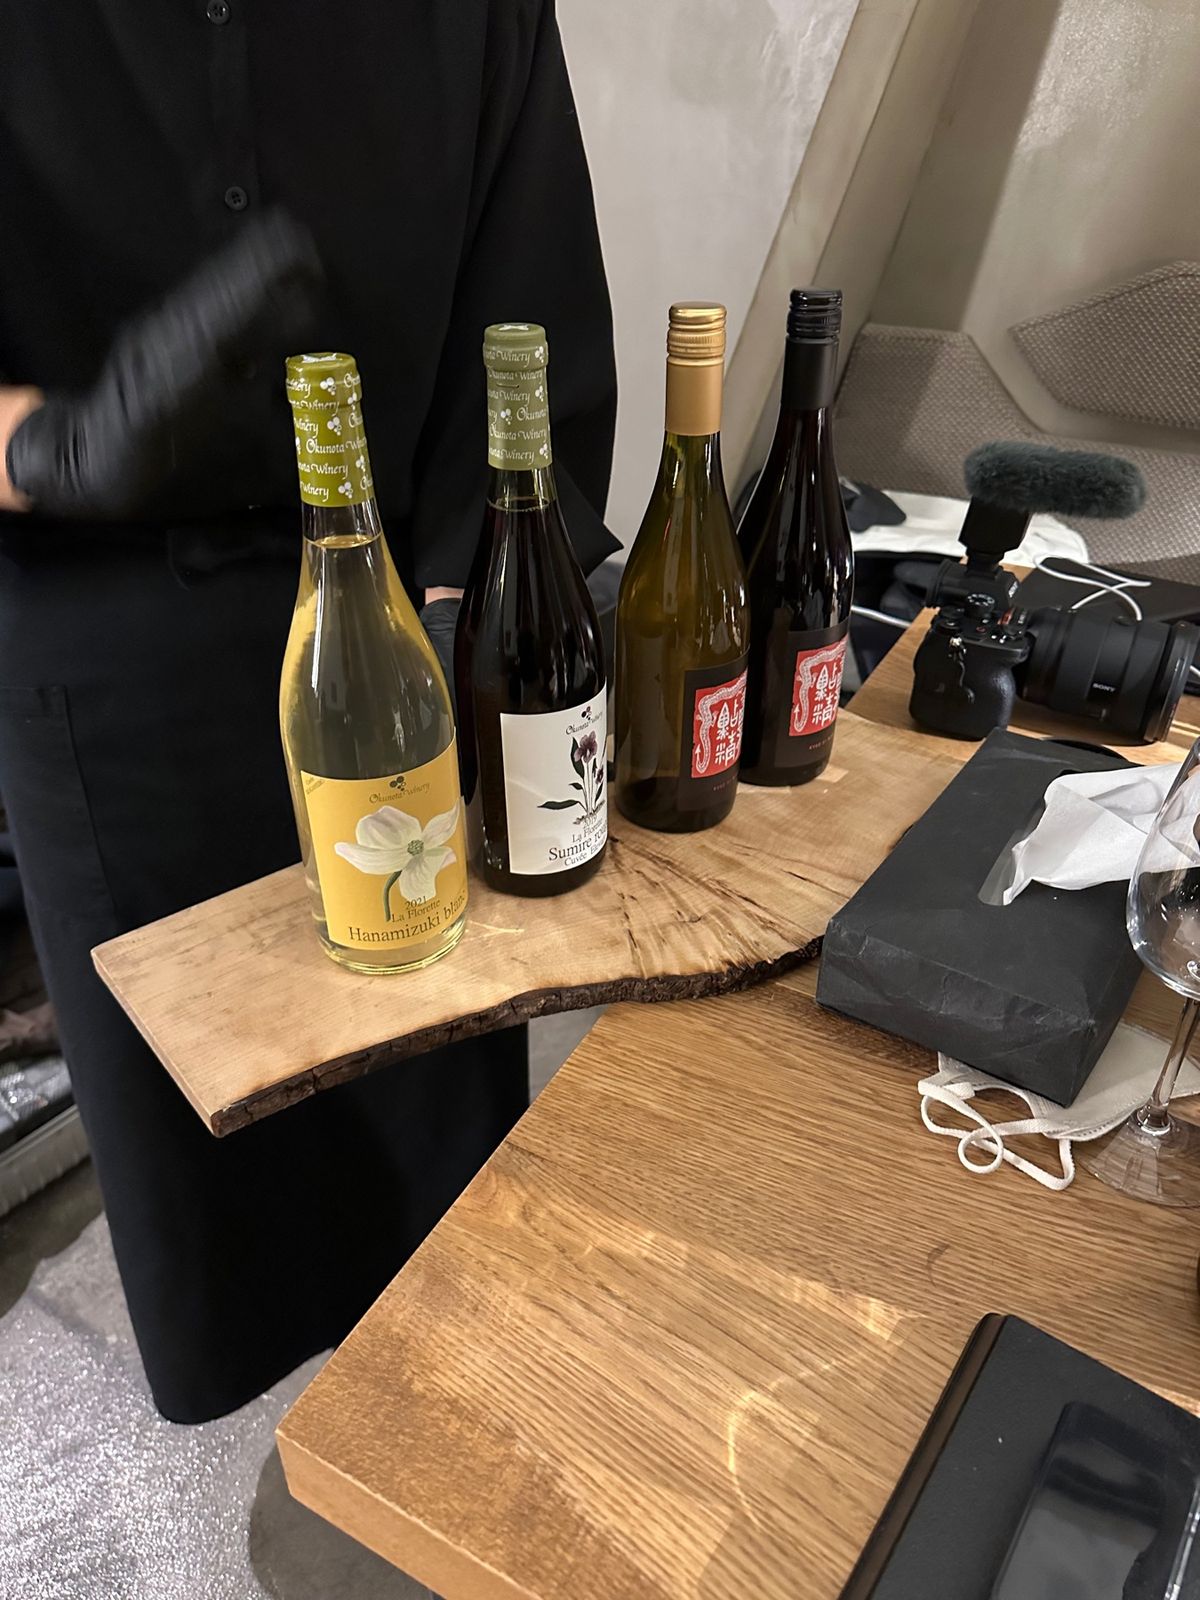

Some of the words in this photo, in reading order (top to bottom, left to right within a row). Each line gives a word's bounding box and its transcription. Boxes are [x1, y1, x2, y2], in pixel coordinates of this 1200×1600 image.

[496, 350, 531, 368] Winery
[499, 389, 530, 407] Winery
[306, 438, 345, 454] Okunota
[501, 448, 534, 466] Winery
[311, 462, 349, 480] Winery
[1092, 682, 1117, 693] SONY
[369, 792, 402, 804] Okunota
[549, 836, 592, 861] Sumire
[564, 852, 587, 866] Cuvée
[391, 913, 404, 923] La
[408, 899, 441, 919] Florette
[405, 896, 427, 910] 2021
[348, 911, 441, 942] Hanamizuki
